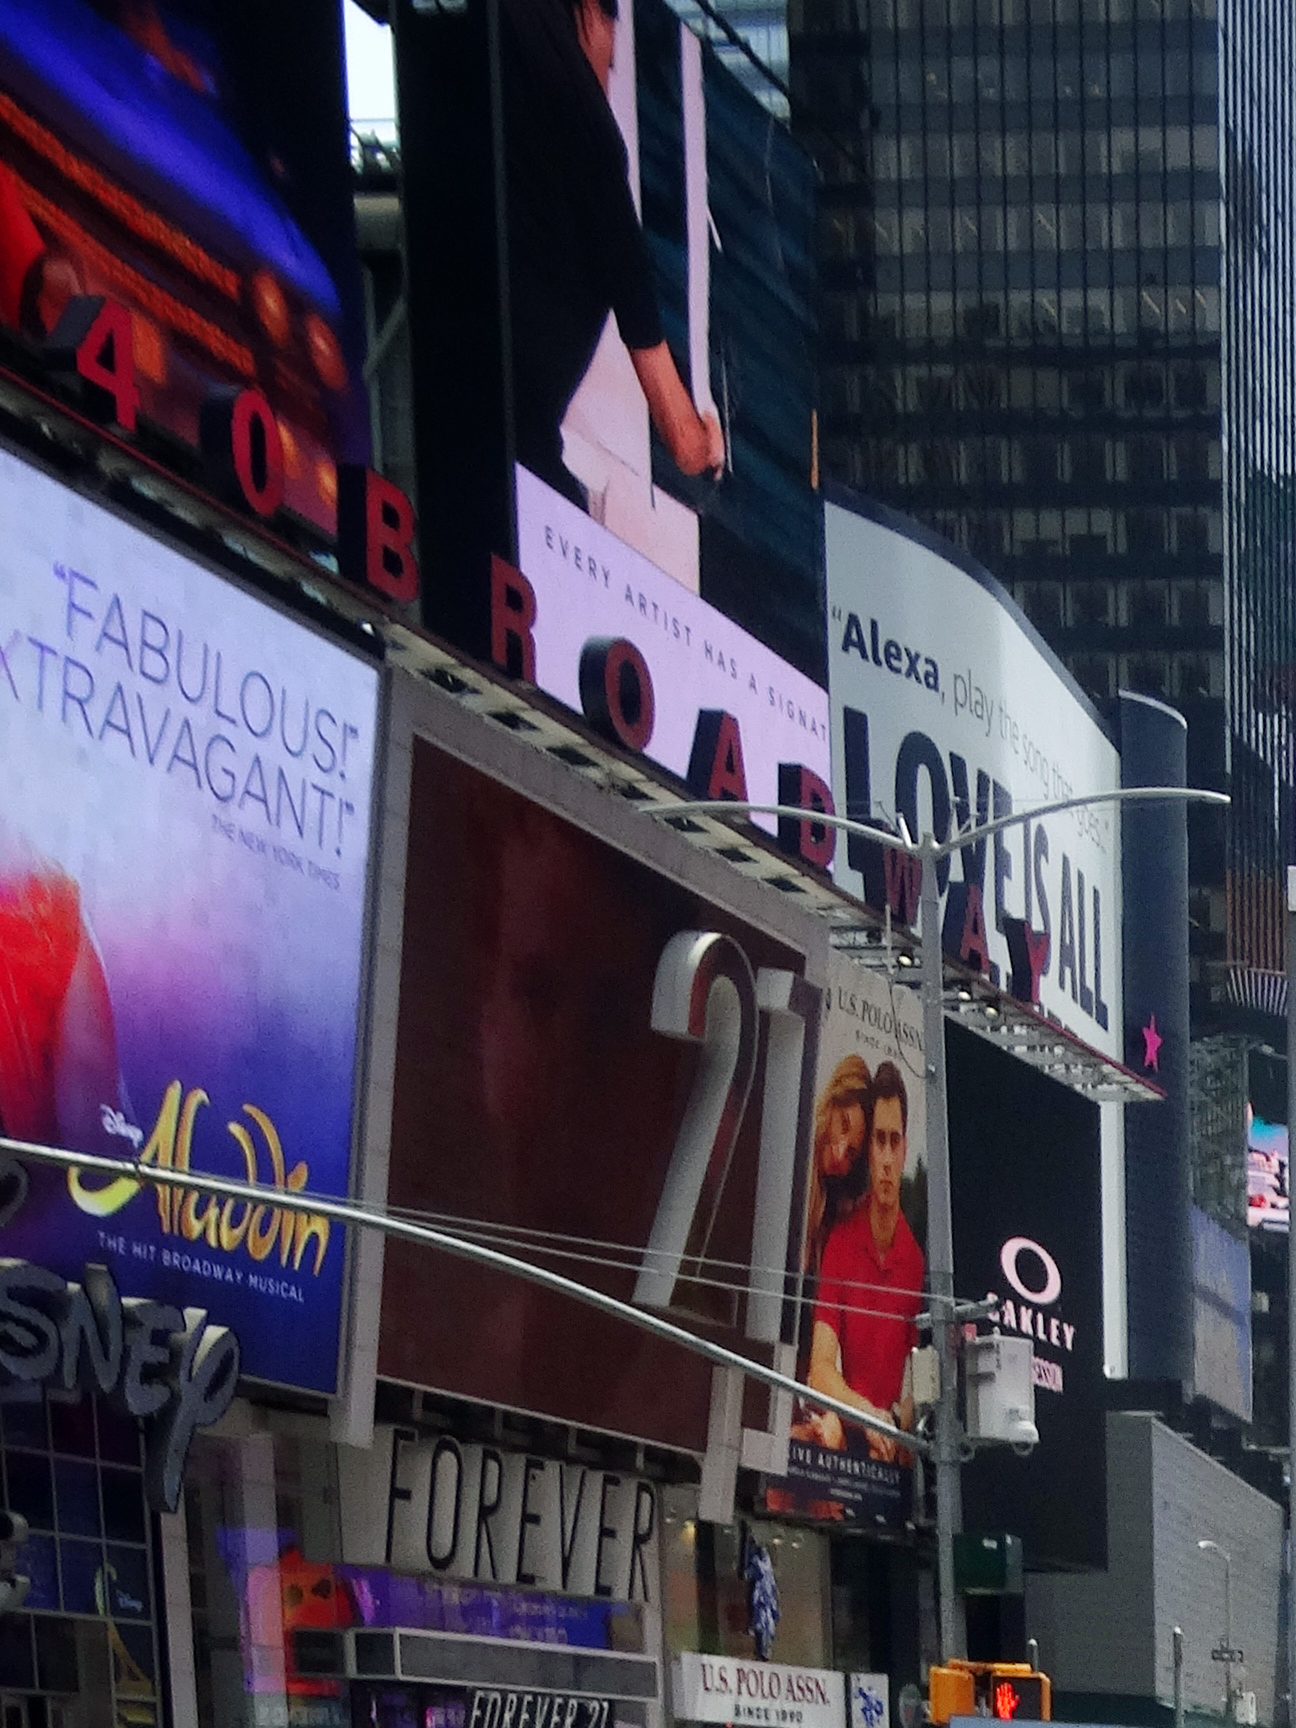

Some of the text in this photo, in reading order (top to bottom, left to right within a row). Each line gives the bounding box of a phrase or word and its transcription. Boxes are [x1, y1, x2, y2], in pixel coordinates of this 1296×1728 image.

[544, 524, 613, 589] EVERY
[623, 583, 694, 649] ARTIST
[703, 639, 739, 680] HAS
[748, 672, 758, 696] A
[953, 668, 994, 738] play
[1058, 852, 1109, 1033] ALL
[67, 1079, 332, 1276] Aladdin
[633, 929, 804, 1343] 21
[98, 1230, 305, 1303] THE HIT BROADWAY MUSICAL
[384, 1427, 661, 1605] FOREVER
[700, 1663, 831, 1706] U.S. POLO ASSN.
